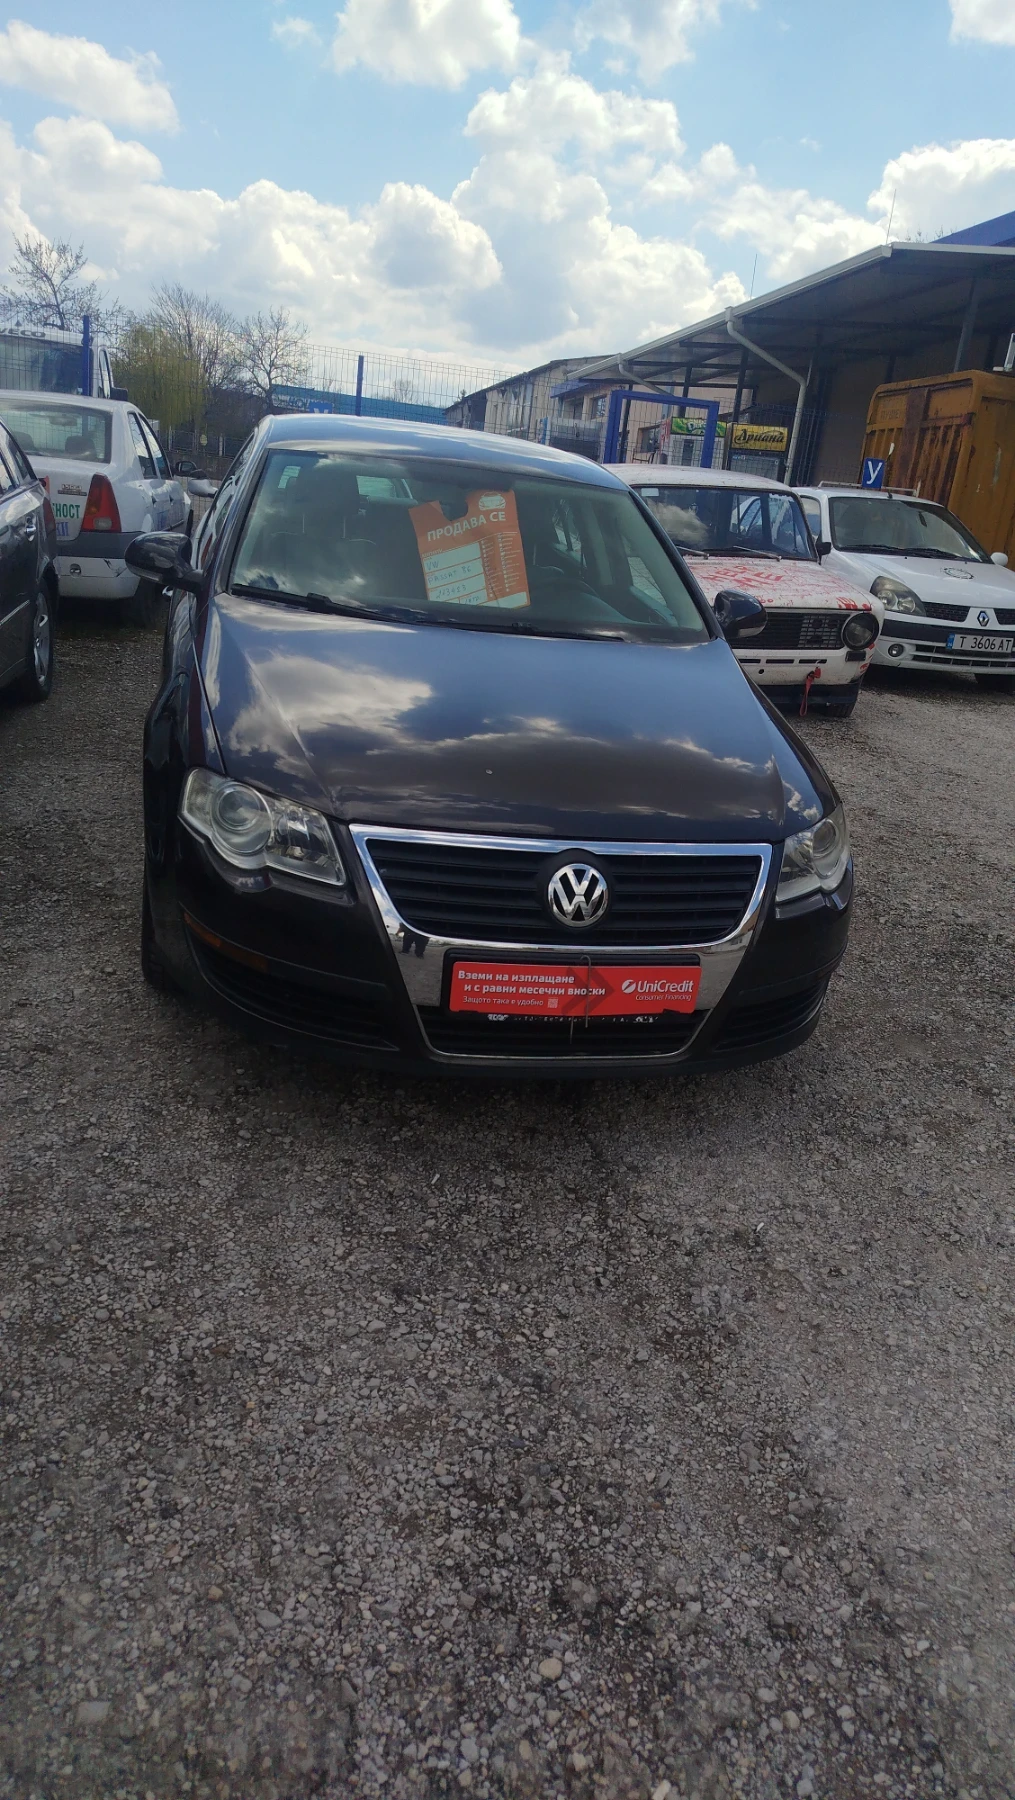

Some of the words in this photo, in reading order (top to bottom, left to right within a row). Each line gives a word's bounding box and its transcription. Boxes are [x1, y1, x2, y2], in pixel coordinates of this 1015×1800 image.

[0, 328, 45, 337] VECO
[733, 428, 784, 445] Ариана
[52, 503, 80, 519] НОСТ
[427, 514, 487, 541] ПРОДАВА
[489, 511, 506, 522] СЕ
[428, 570, 456, 585] PASSAT
[959, 636, 967, 648] T
[971, 637, 996, 650] 3606
[998, 639, 1012, 651] AT
[458, 970, 493, 981] Вземи
[512, 974, 575, 985] изплащане
[464, 983, 472, 991] и
[482, 985, 517, 994] равни
[519, 986, 565, 995] месечни
[568, 987, 606, 996] вноски
[637, 980, 694, 993] UniCredit
[463, 995, 491, 1005] Защото
[492, 997, 509, 1005] така
[517, 998, 544, 1007] удобно
[664, 994, 691, 1002] Financing
